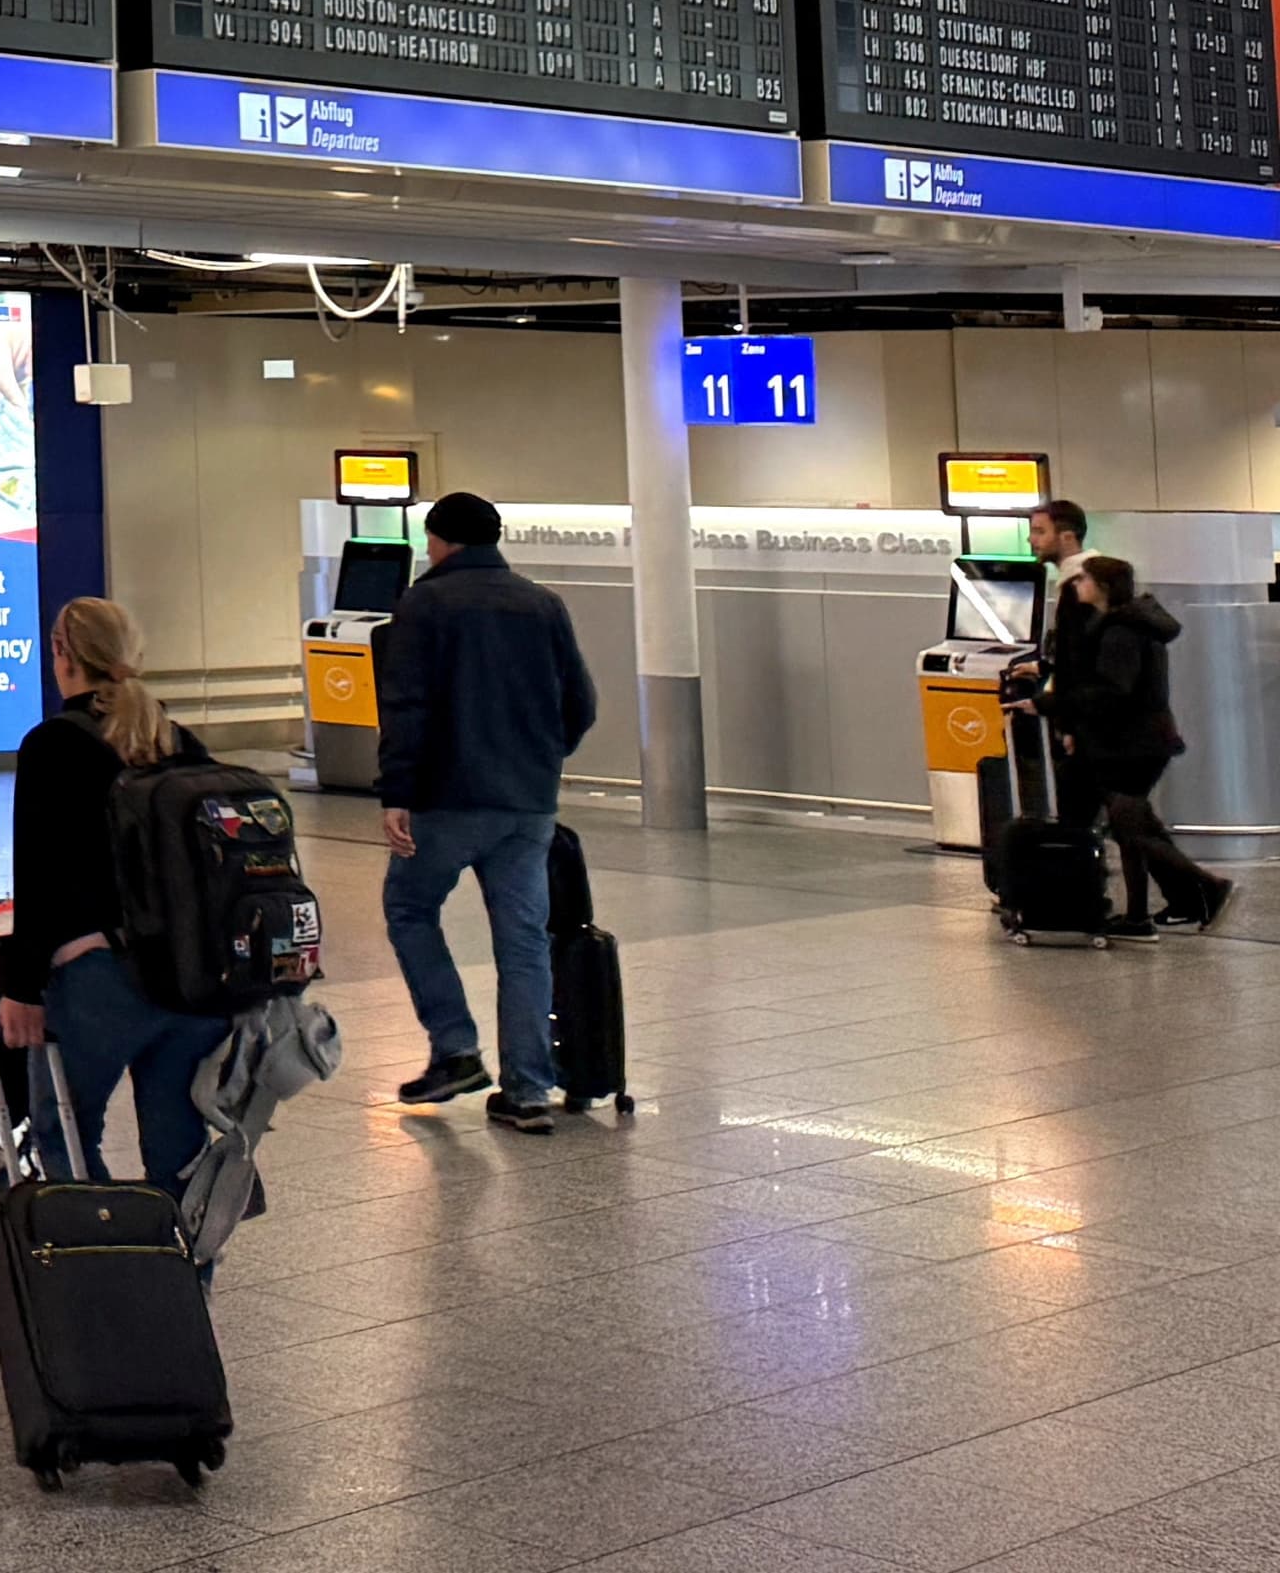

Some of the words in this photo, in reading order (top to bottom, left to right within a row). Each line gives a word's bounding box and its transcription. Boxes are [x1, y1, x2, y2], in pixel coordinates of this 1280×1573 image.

[326, 28, 477, 63] LONDON-HEATHROW
[311, 100, 353, 127] Abflug
[312, 127, 379, 152] Departures
[934, 163, 964, 186] Abflug
[935, 186, 982, 207] Departures
[703, 374, 730, 417] 11
[768, 374, 806, 417] 11
[503, 525, 616, 546] Lufthansa
[756, 529, 872, 553] Business
[877, 532, 952, 555] Class
